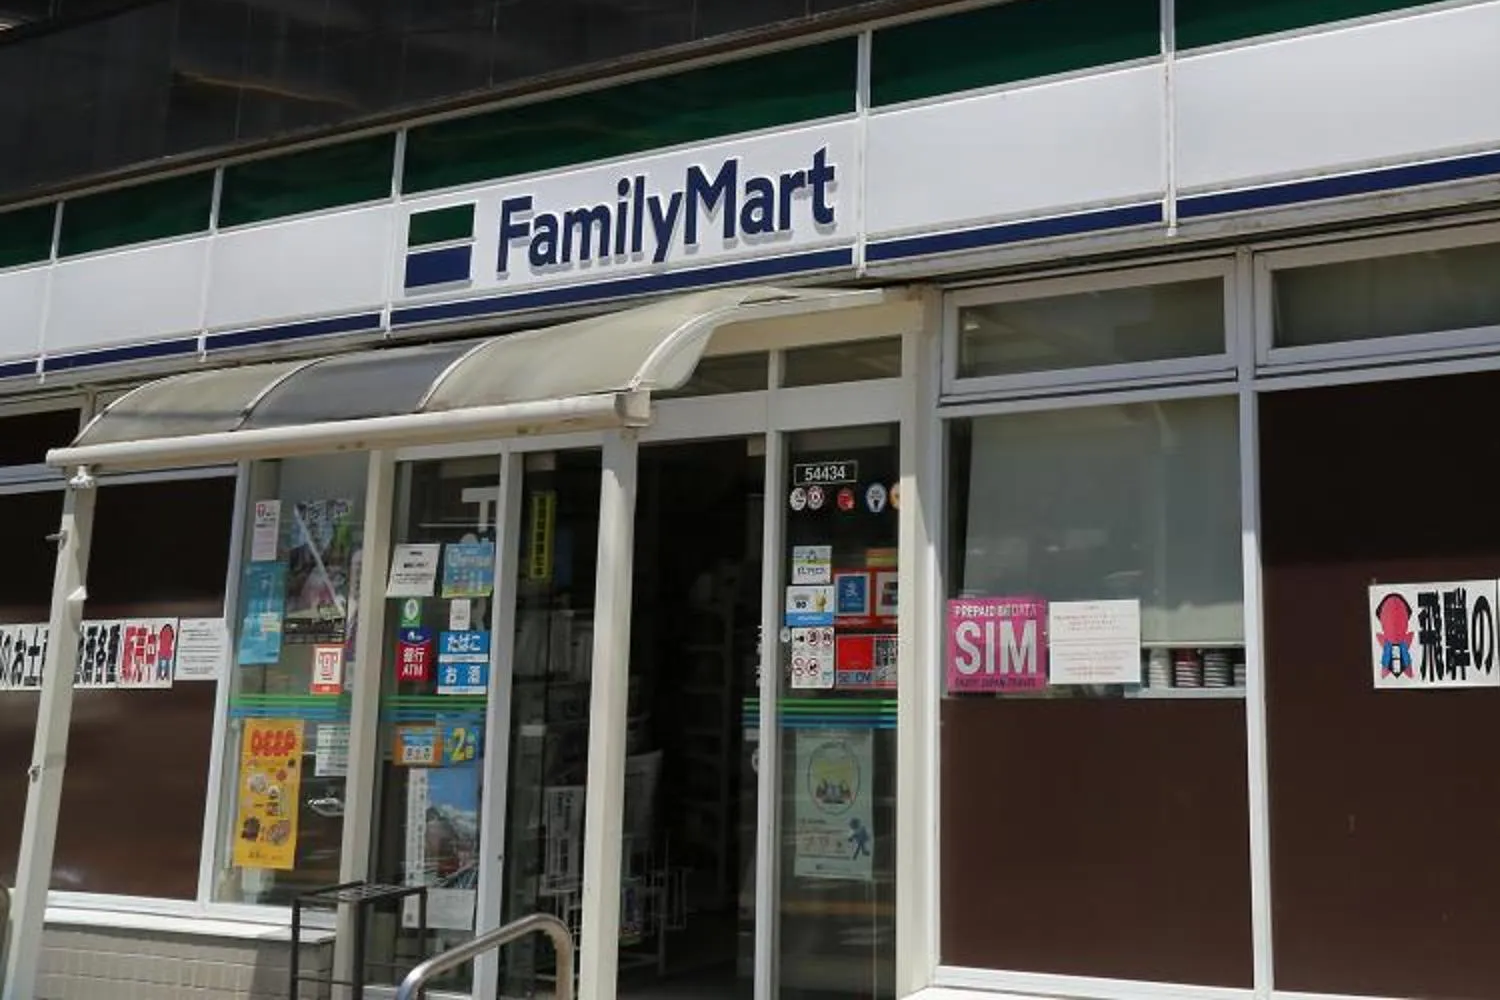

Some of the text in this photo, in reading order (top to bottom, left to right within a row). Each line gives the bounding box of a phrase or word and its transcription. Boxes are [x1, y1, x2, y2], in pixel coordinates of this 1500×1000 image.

[496, 146, 837, 273] FamilyMart
[804, 465, 846, 481] 54434
[955, 604, 995, 617] PREPAID
[403, 647, 425, 662] 銀行
[955, 619, 1037, 675] SIM
[402, 663, 424, 677] ATM
